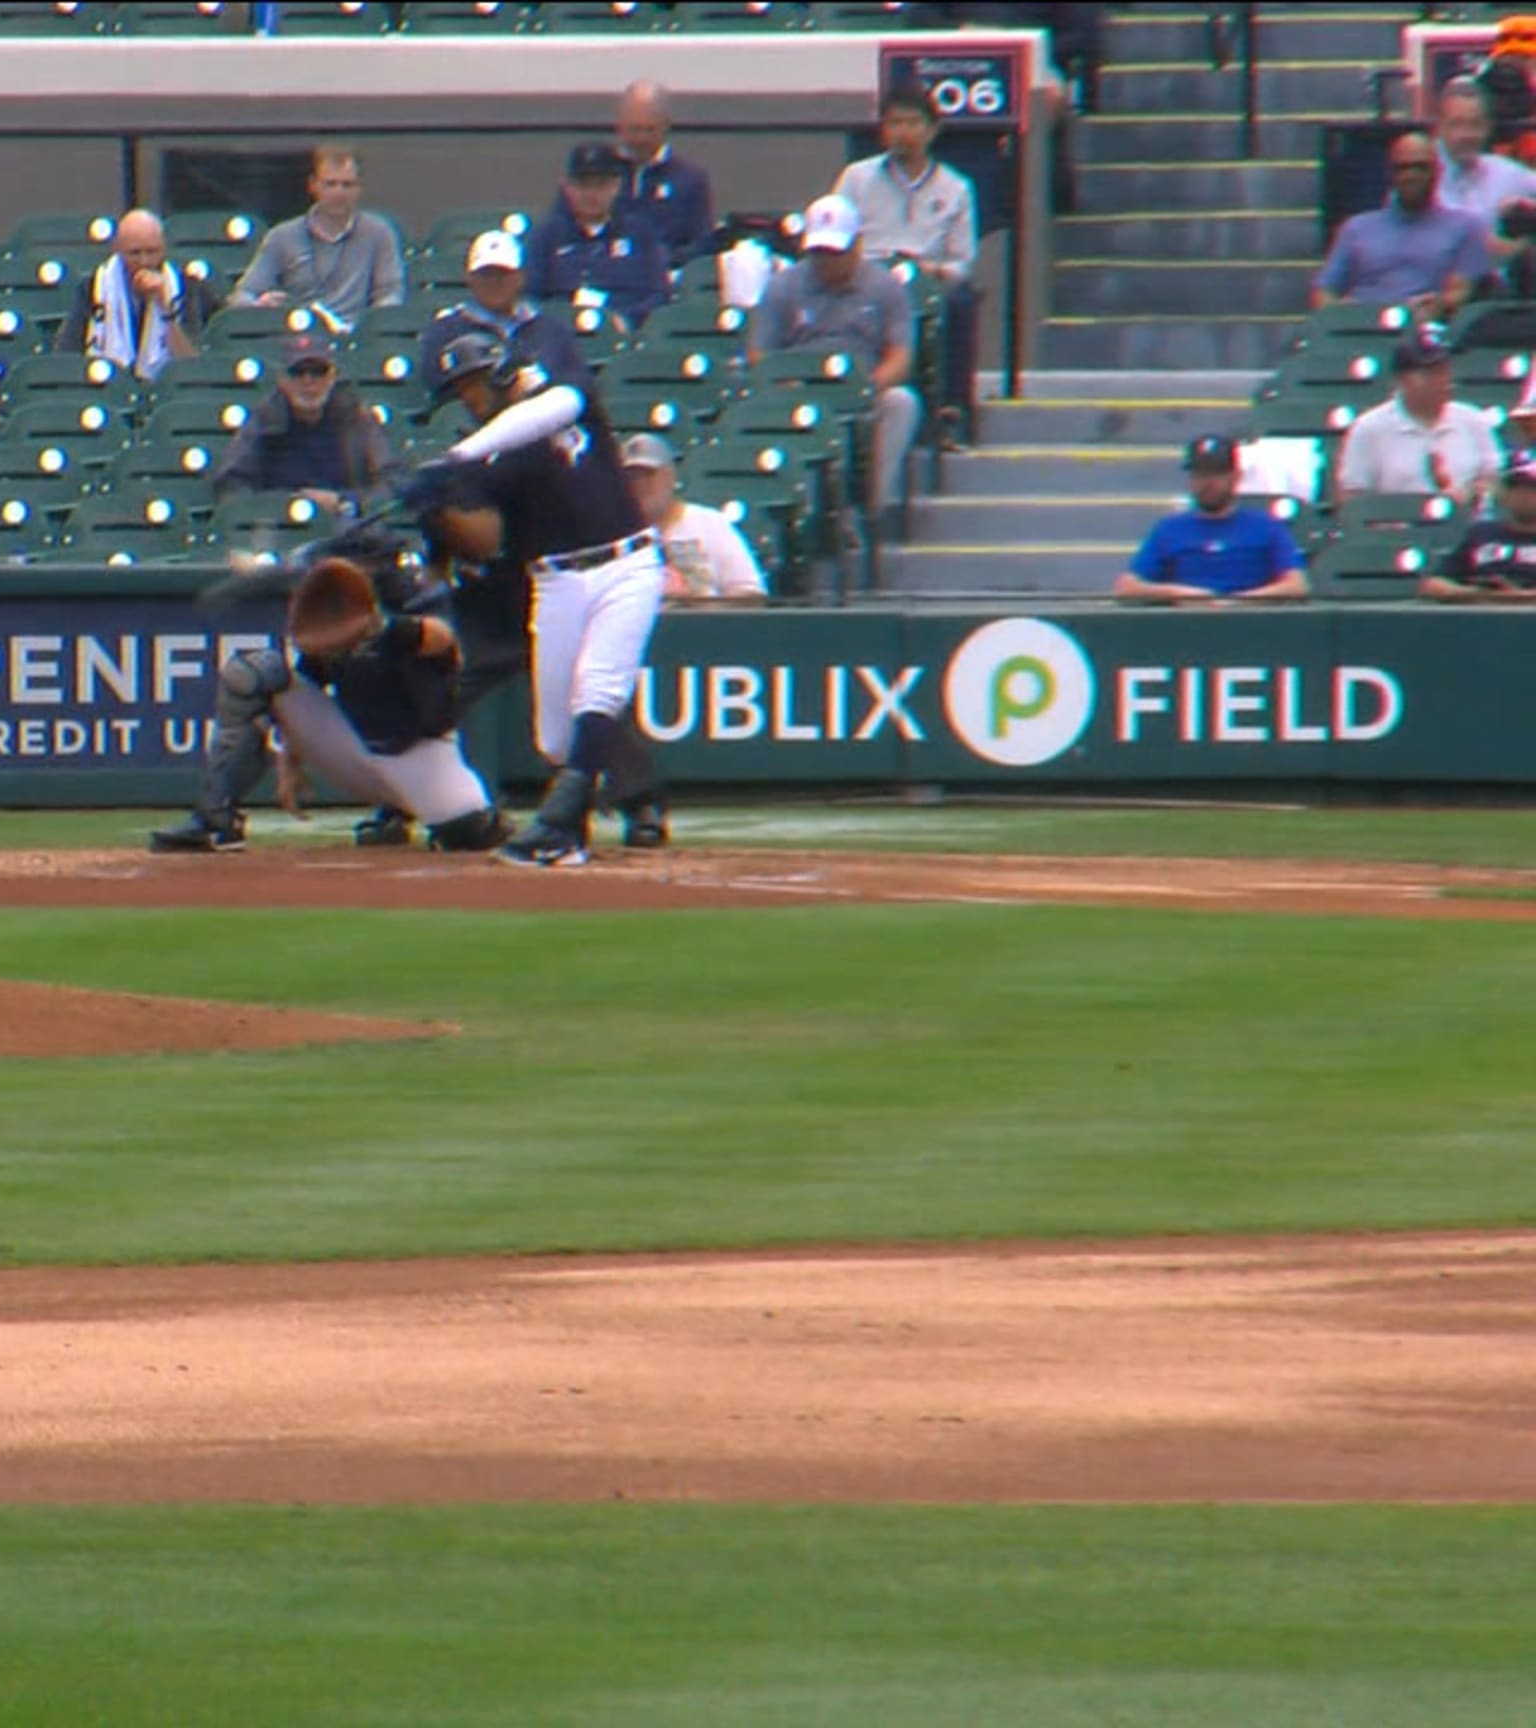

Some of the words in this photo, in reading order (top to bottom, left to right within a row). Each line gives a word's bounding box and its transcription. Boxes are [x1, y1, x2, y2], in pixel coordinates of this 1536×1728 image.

[922, 78, 1004, 114] 06
[632, 665, 926, 742] UBLIX
[1117, 666, 1404, 742] FIELD
